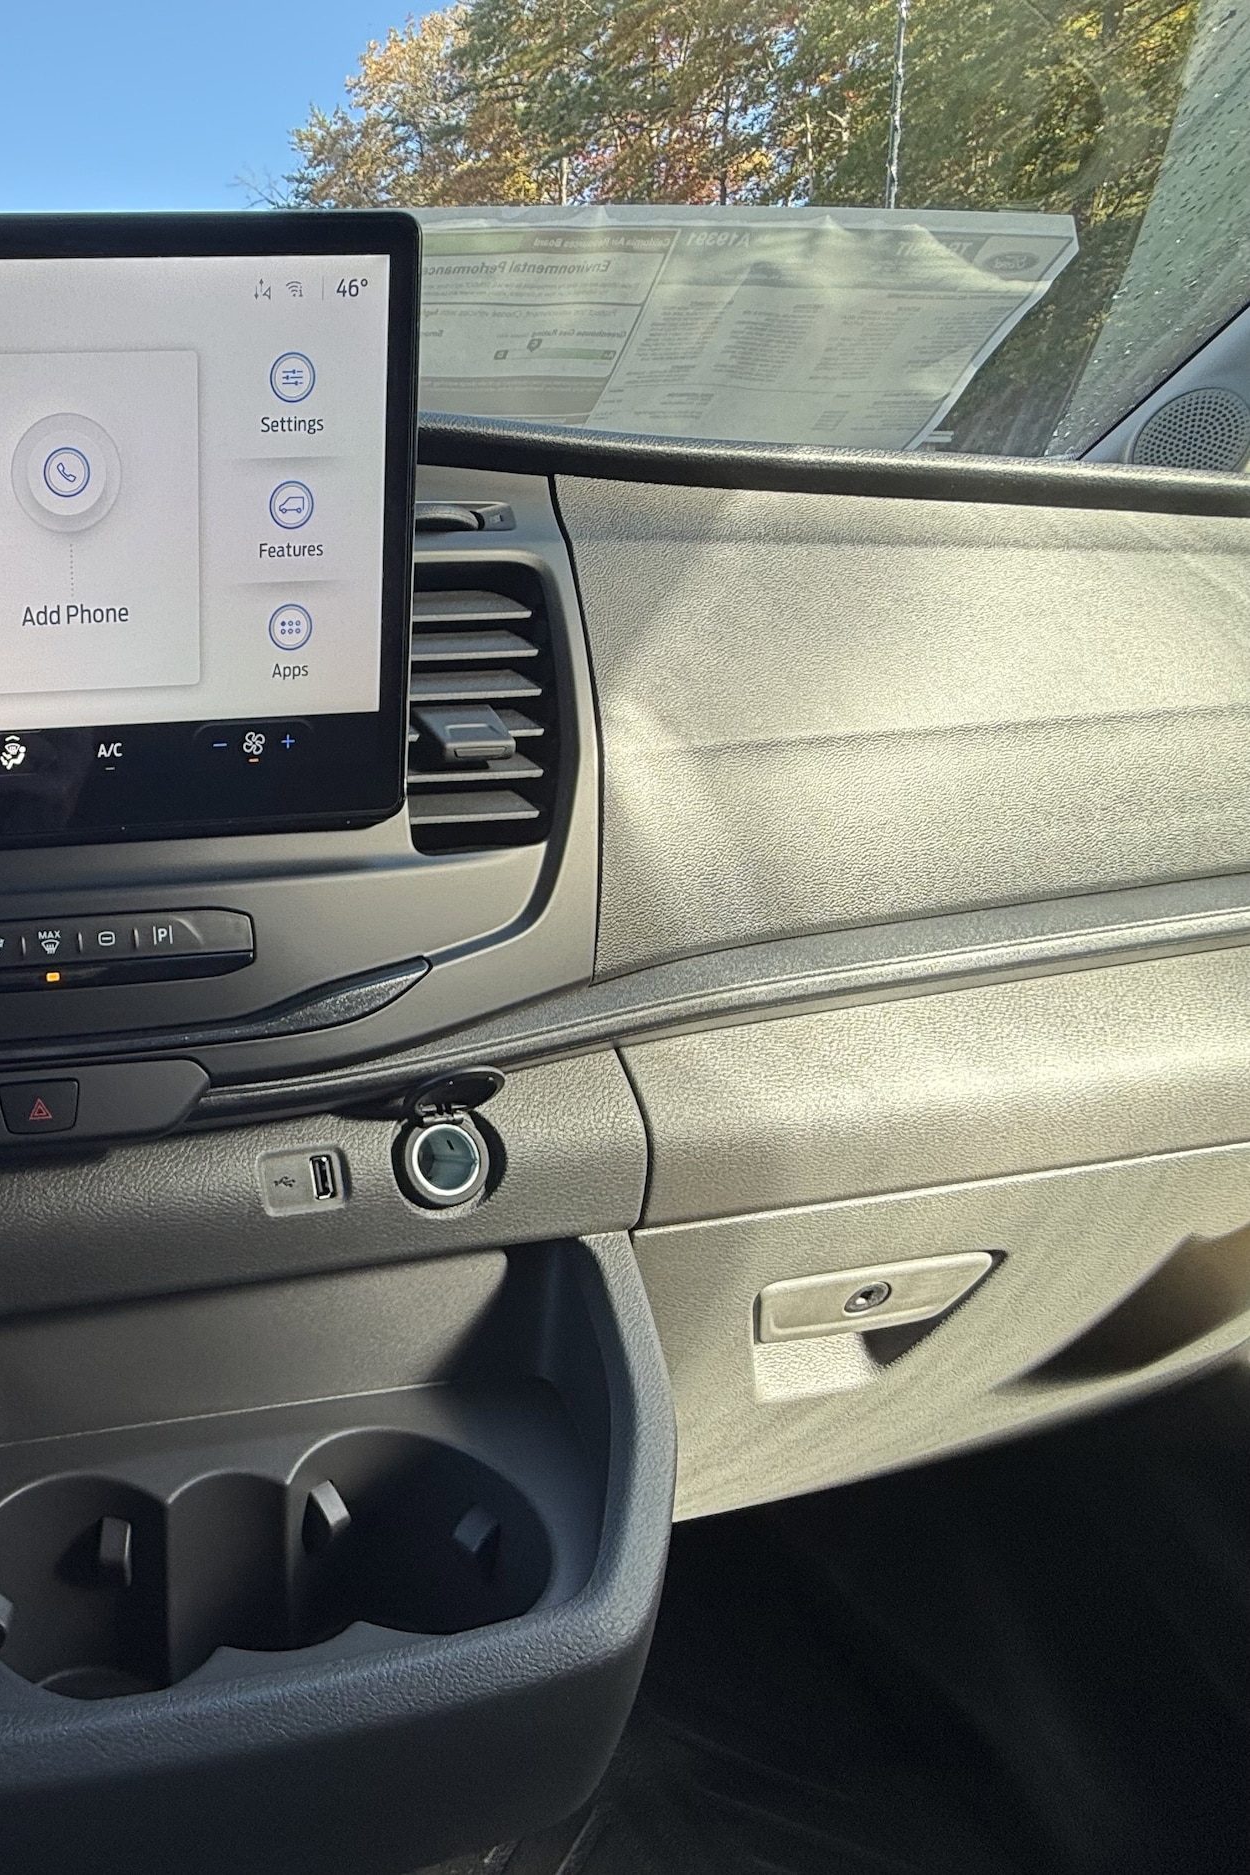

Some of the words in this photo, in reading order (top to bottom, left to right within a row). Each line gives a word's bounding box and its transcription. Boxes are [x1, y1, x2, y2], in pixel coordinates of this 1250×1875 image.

[335, 277, 369, 298] 46°
[260, 416, 324, 435] Settings
[258, 541, 324, 559] Features
[21, 605, 61, 627] Add
[66, 603, 129, 625] Phone
[271, 662, 309, 680] Apps
[97, 742, 122, 759] A/C
[38, 930, 61, 940] MAX
